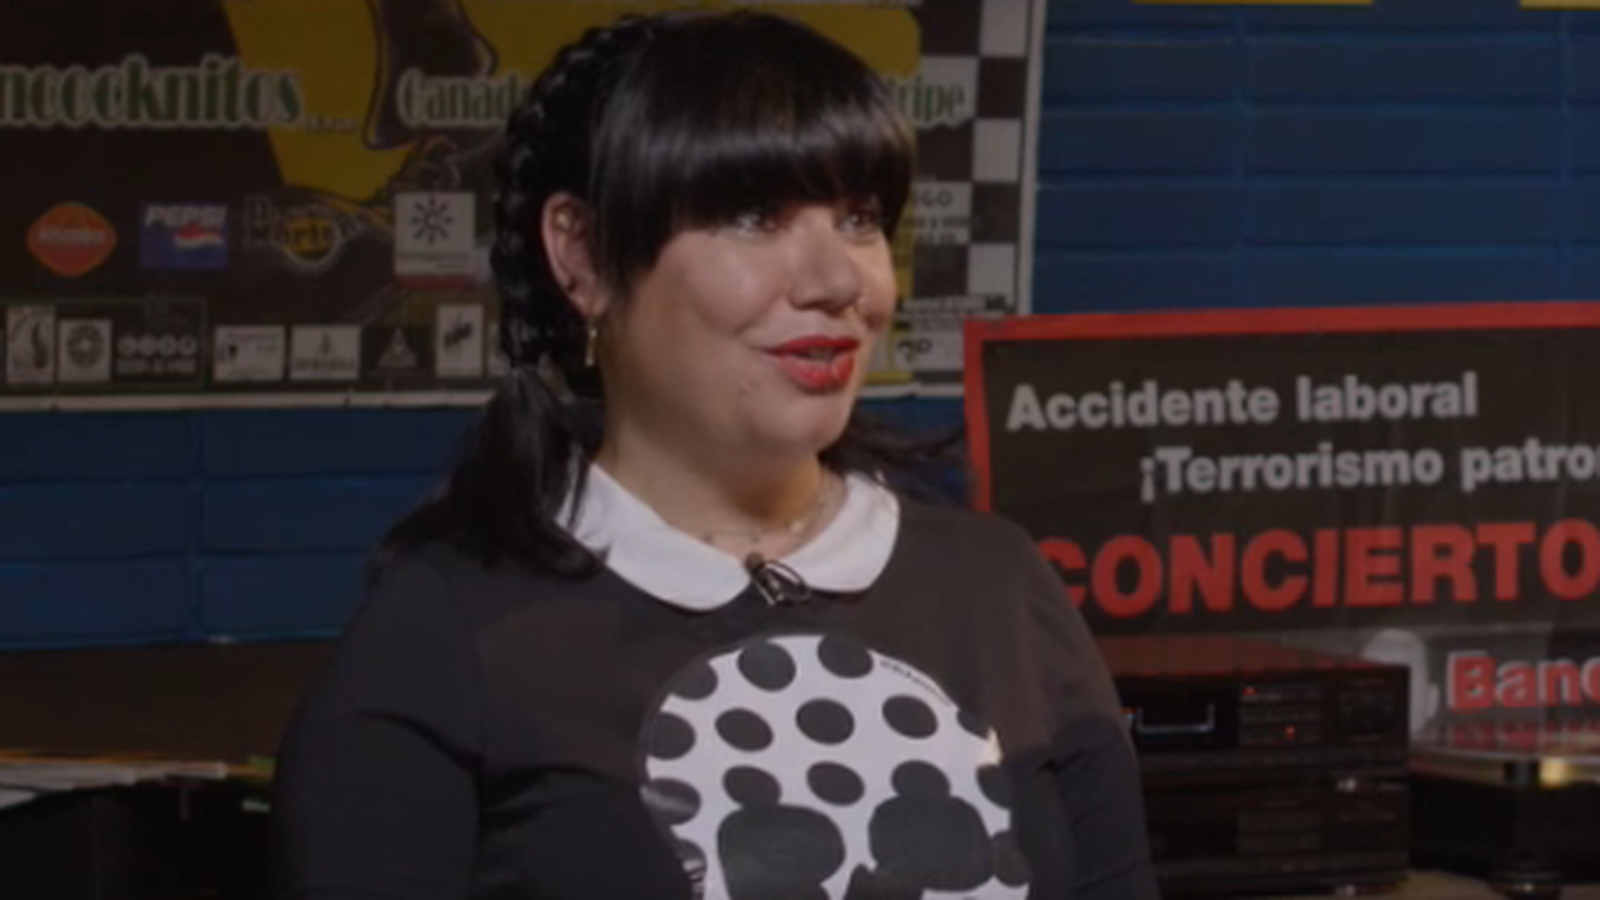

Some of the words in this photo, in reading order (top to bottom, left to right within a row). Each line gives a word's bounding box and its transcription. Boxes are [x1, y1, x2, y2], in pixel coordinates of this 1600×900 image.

[144, 204, 228, 227] PEPSI
[1005, 378, 1280, 432] Accidente
[1296, 371, 1479, 422] laboral
[1139, 441, 1444, 504] ¡Terrorismo
[1461, 436, 1600, 494] patro
